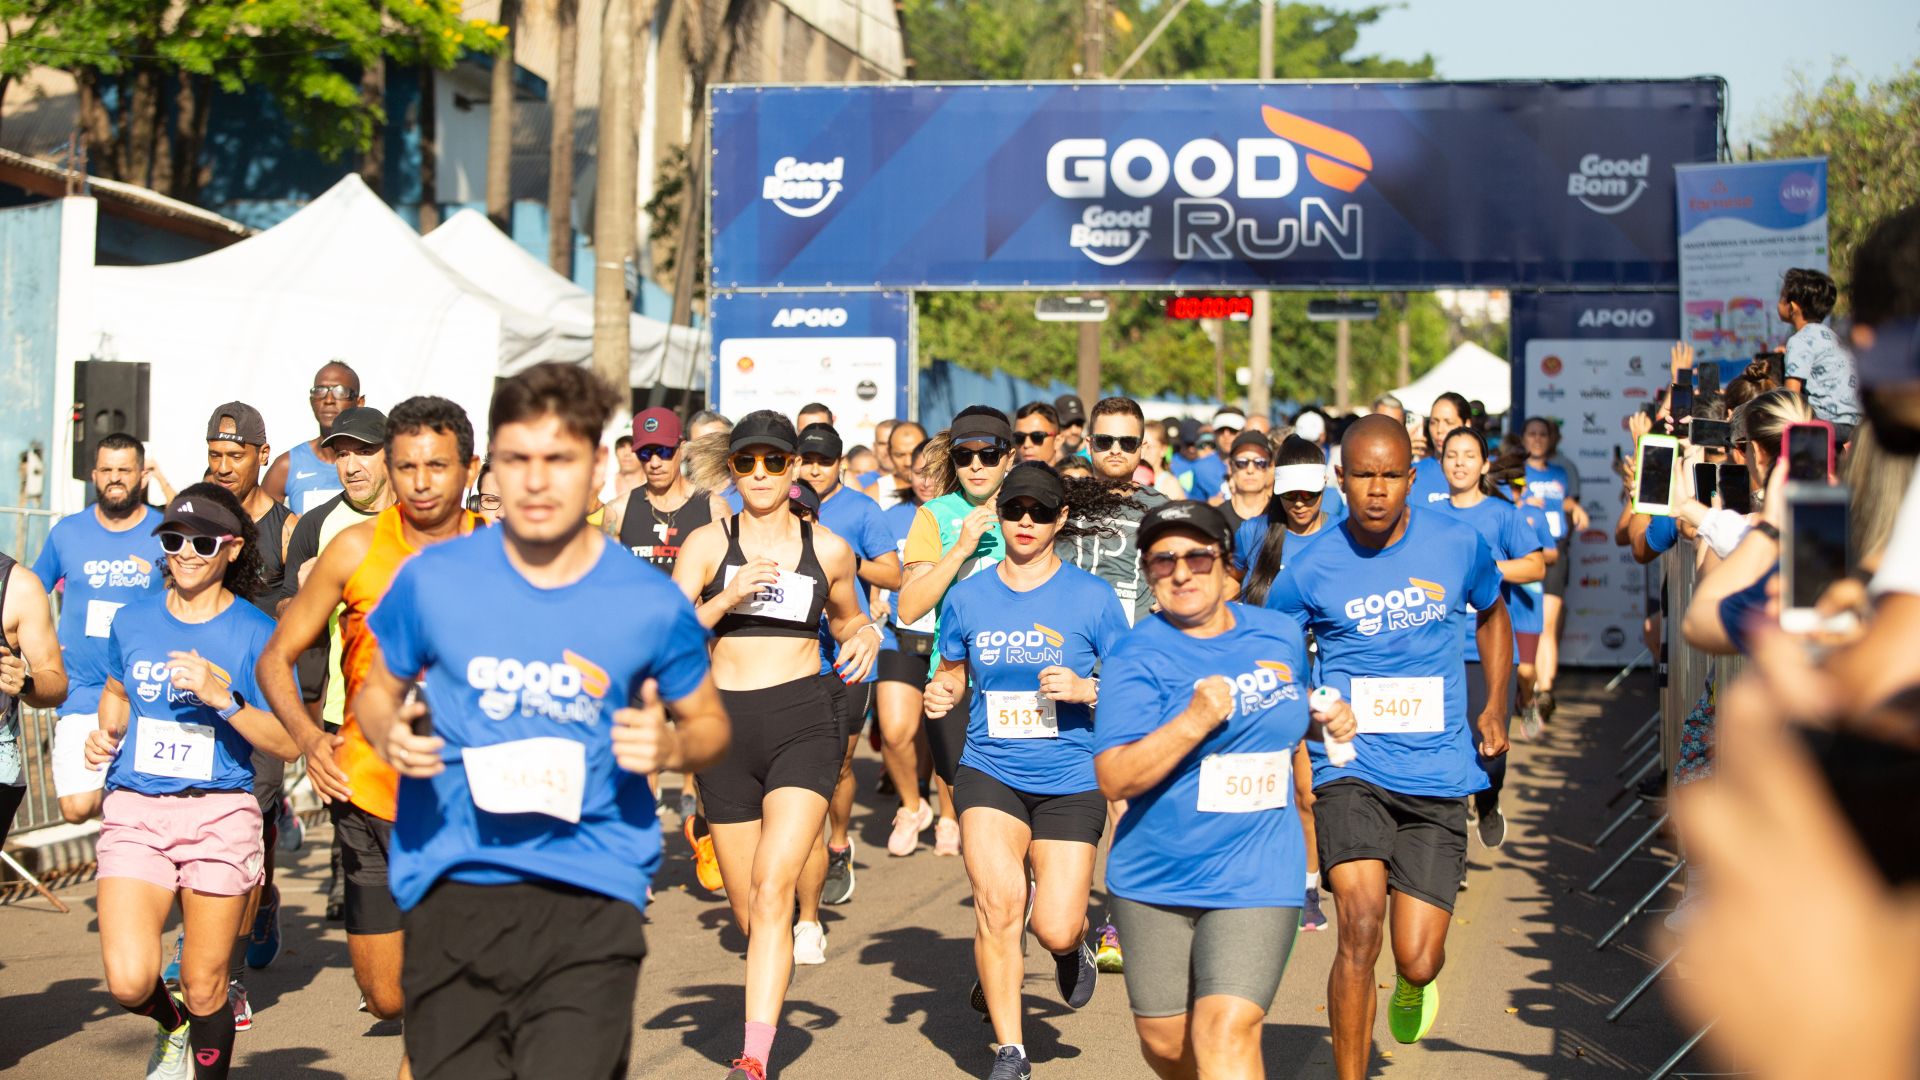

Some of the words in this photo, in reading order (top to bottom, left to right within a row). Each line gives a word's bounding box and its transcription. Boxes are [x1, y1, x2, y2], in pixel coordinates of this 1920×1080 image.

[774, 156, 844, 181] Good
[1046, 138, 1299, 199] GOOD
[1580, 153, 1649, 177] Good
[762, 176, 824, 199] Bom
[1567, 173, 1628, 196] Bom
[1082, 205, 1152, 228] Good
[1070, 224, 1131, 247] Bom
[771, 307, 848, 328] APOIO
[1577, 309, 1655, 328] APOIO
[83, 560, 138, 575] GOOD
[1345, 587, 1425, 620] GOOD
[976, 630, 1043, 648] GOOD
[467, 656, 582, 698] GOOD
[999, 709, 1044, 726] 5137
[1374, 698, 1422, 717] 5407
[153, 741, 192, 761] 217
[1226, 773, 1276, 796] 5016
